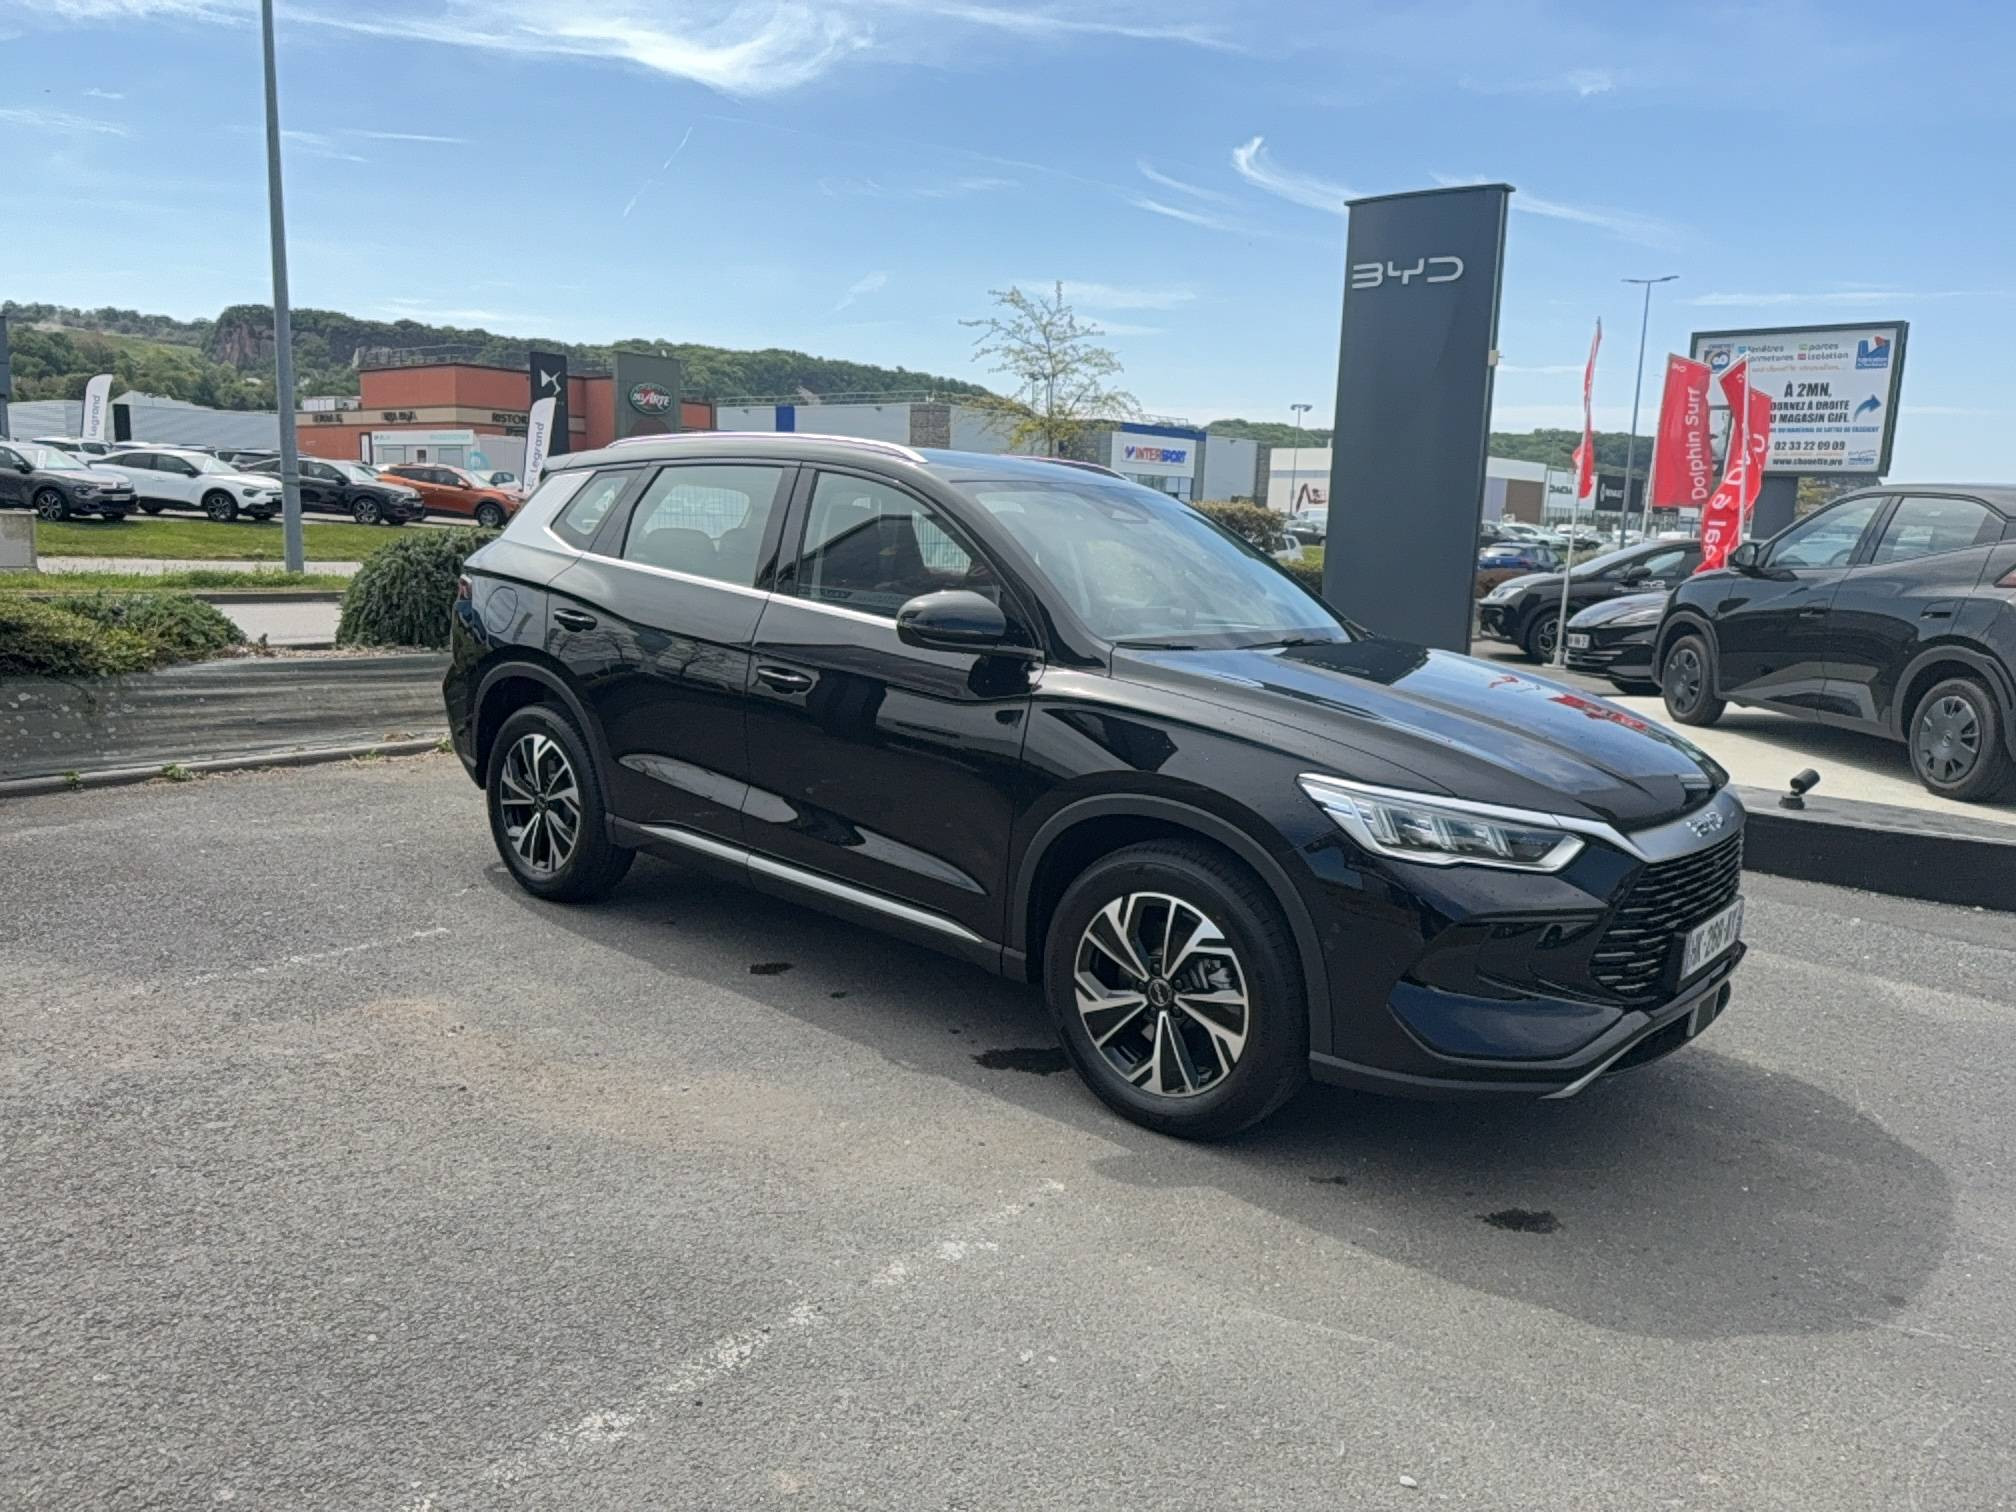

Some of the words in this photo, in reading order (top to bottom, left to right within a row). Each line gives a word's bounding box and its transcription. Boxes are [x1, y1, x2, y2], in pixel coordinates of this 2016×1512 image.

[1351, 256, 1464, 289] BYD
[1748, 353, 1794, 362] ermetures
[1808, 351, 1849, 360] isolation
[1784, 380, 1794, 397] À
[1770, 401, 1806, 411] OURNEZ
[1816, 400, 1850, 411] DROITE
[88, 393, 102, 437] Legrand
[492, 412, 530, 425] RISTOR
[1770, 413, 1777, 423] U
[1779, 413, 1825, 424] MAGASIN
[530, 420, 545, 474] Legrand
[1774, 441, 1787, 451] 02
[1788, 441, 1802, 451] 33
[1803, 441, 1815, 451] 22
[1135, 447, 1187, 464] INTERSPORT
[1685, 432, 1708, 500] Dolphin
